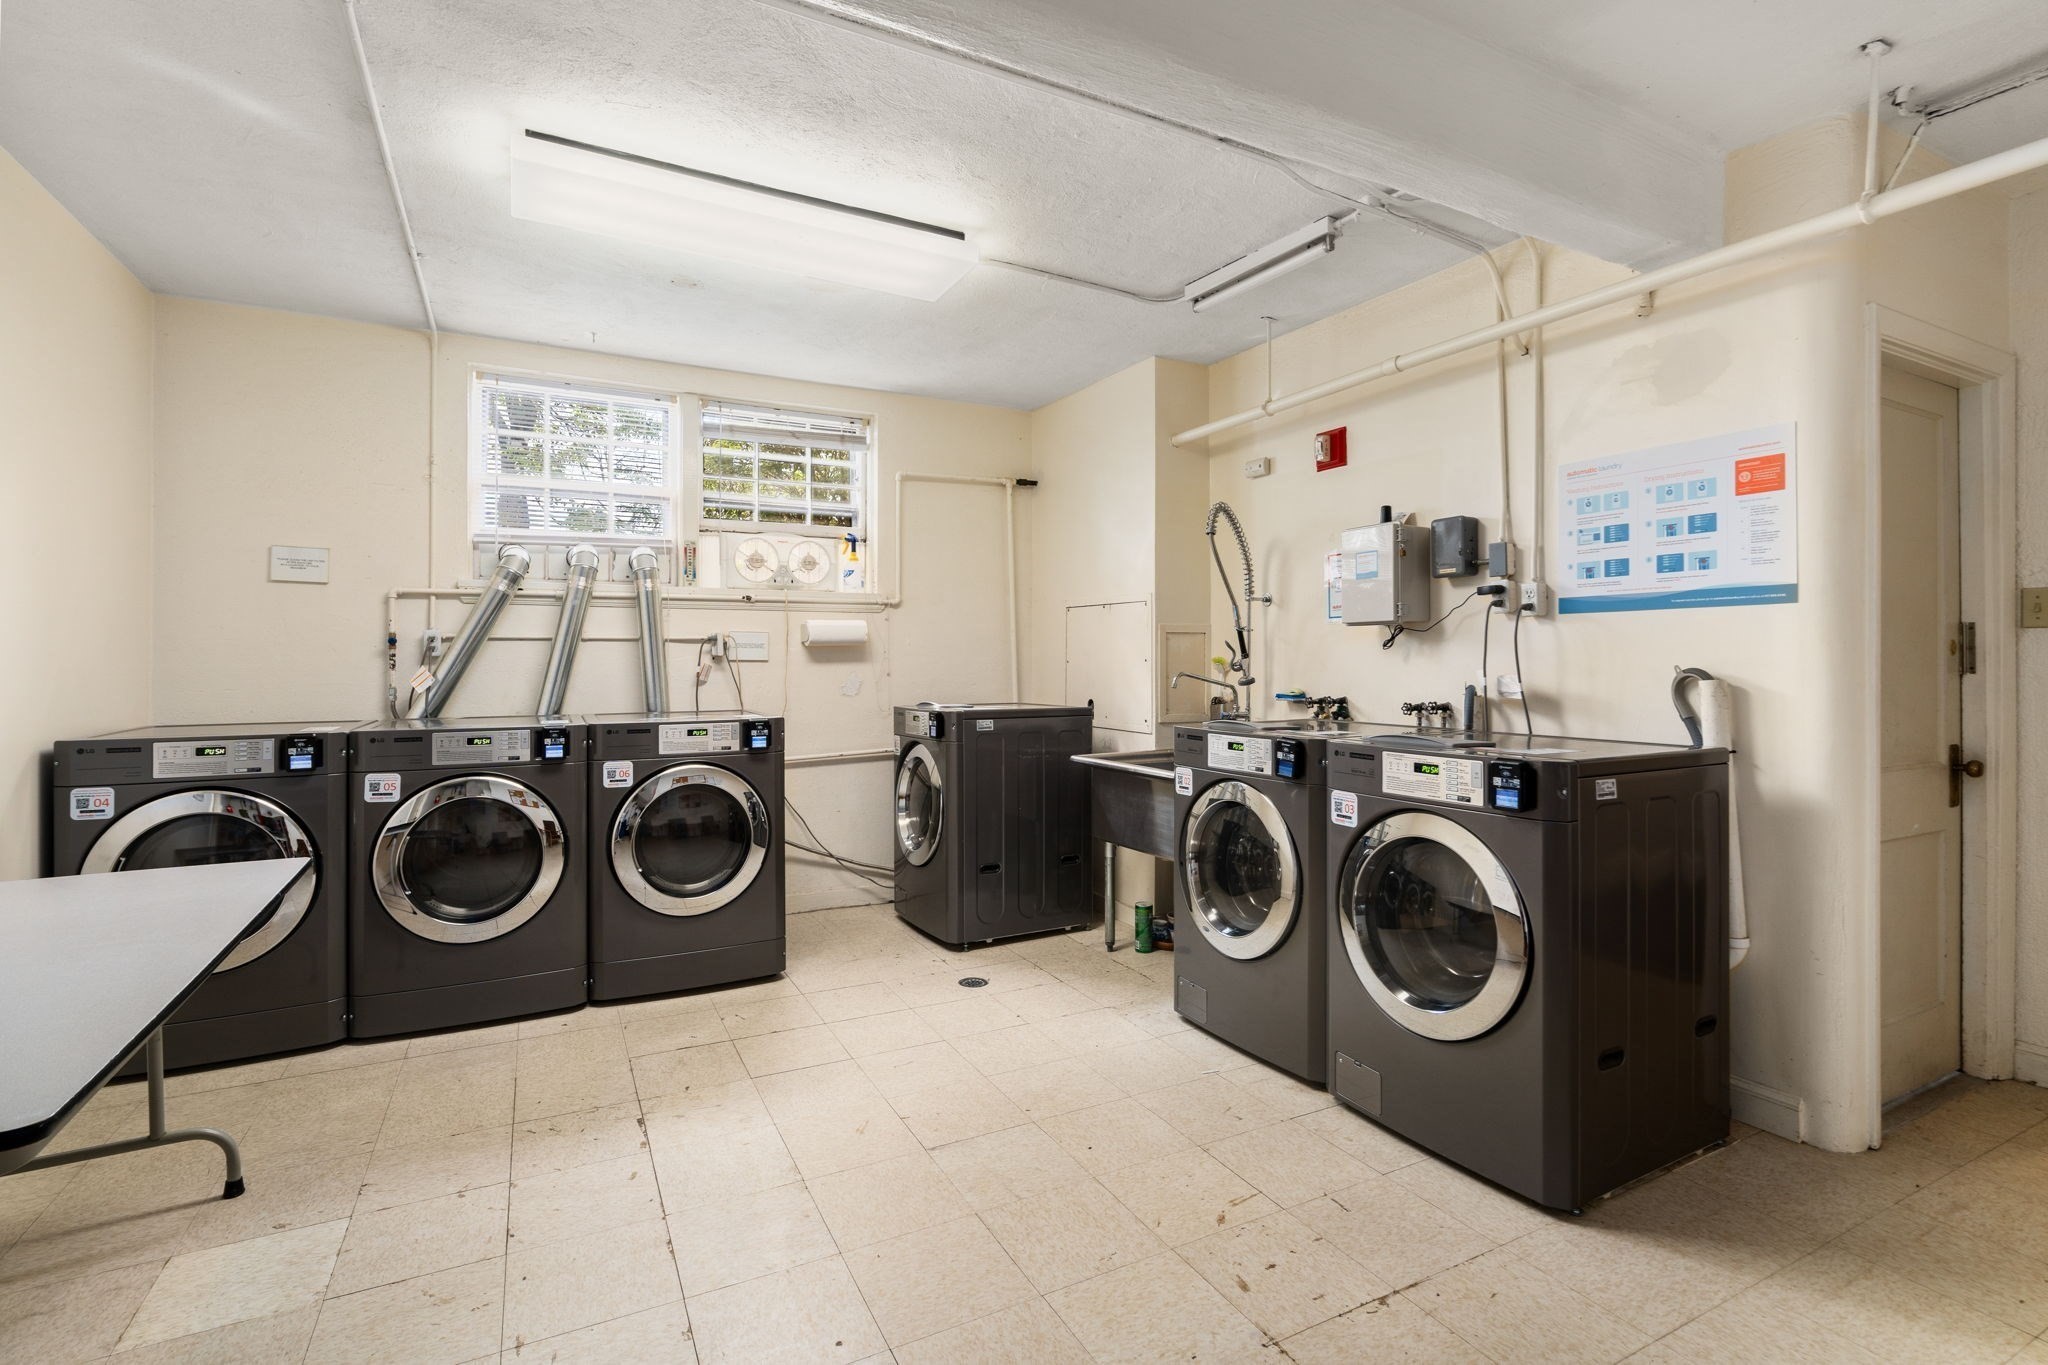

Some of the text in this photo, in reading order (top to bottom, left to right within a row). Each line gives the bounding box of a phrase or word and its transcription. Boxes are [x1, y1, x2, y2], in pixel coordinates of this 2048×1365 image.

[618, 769, 630, 778] 06
[1421, 765, 1439, 774] PUSH
[1183, 776, 1192, 786] 02
[383, 782, 397, 791] 05
[93, 798, 110, 808] 04
[1344, 803, 1355, 815] 03
